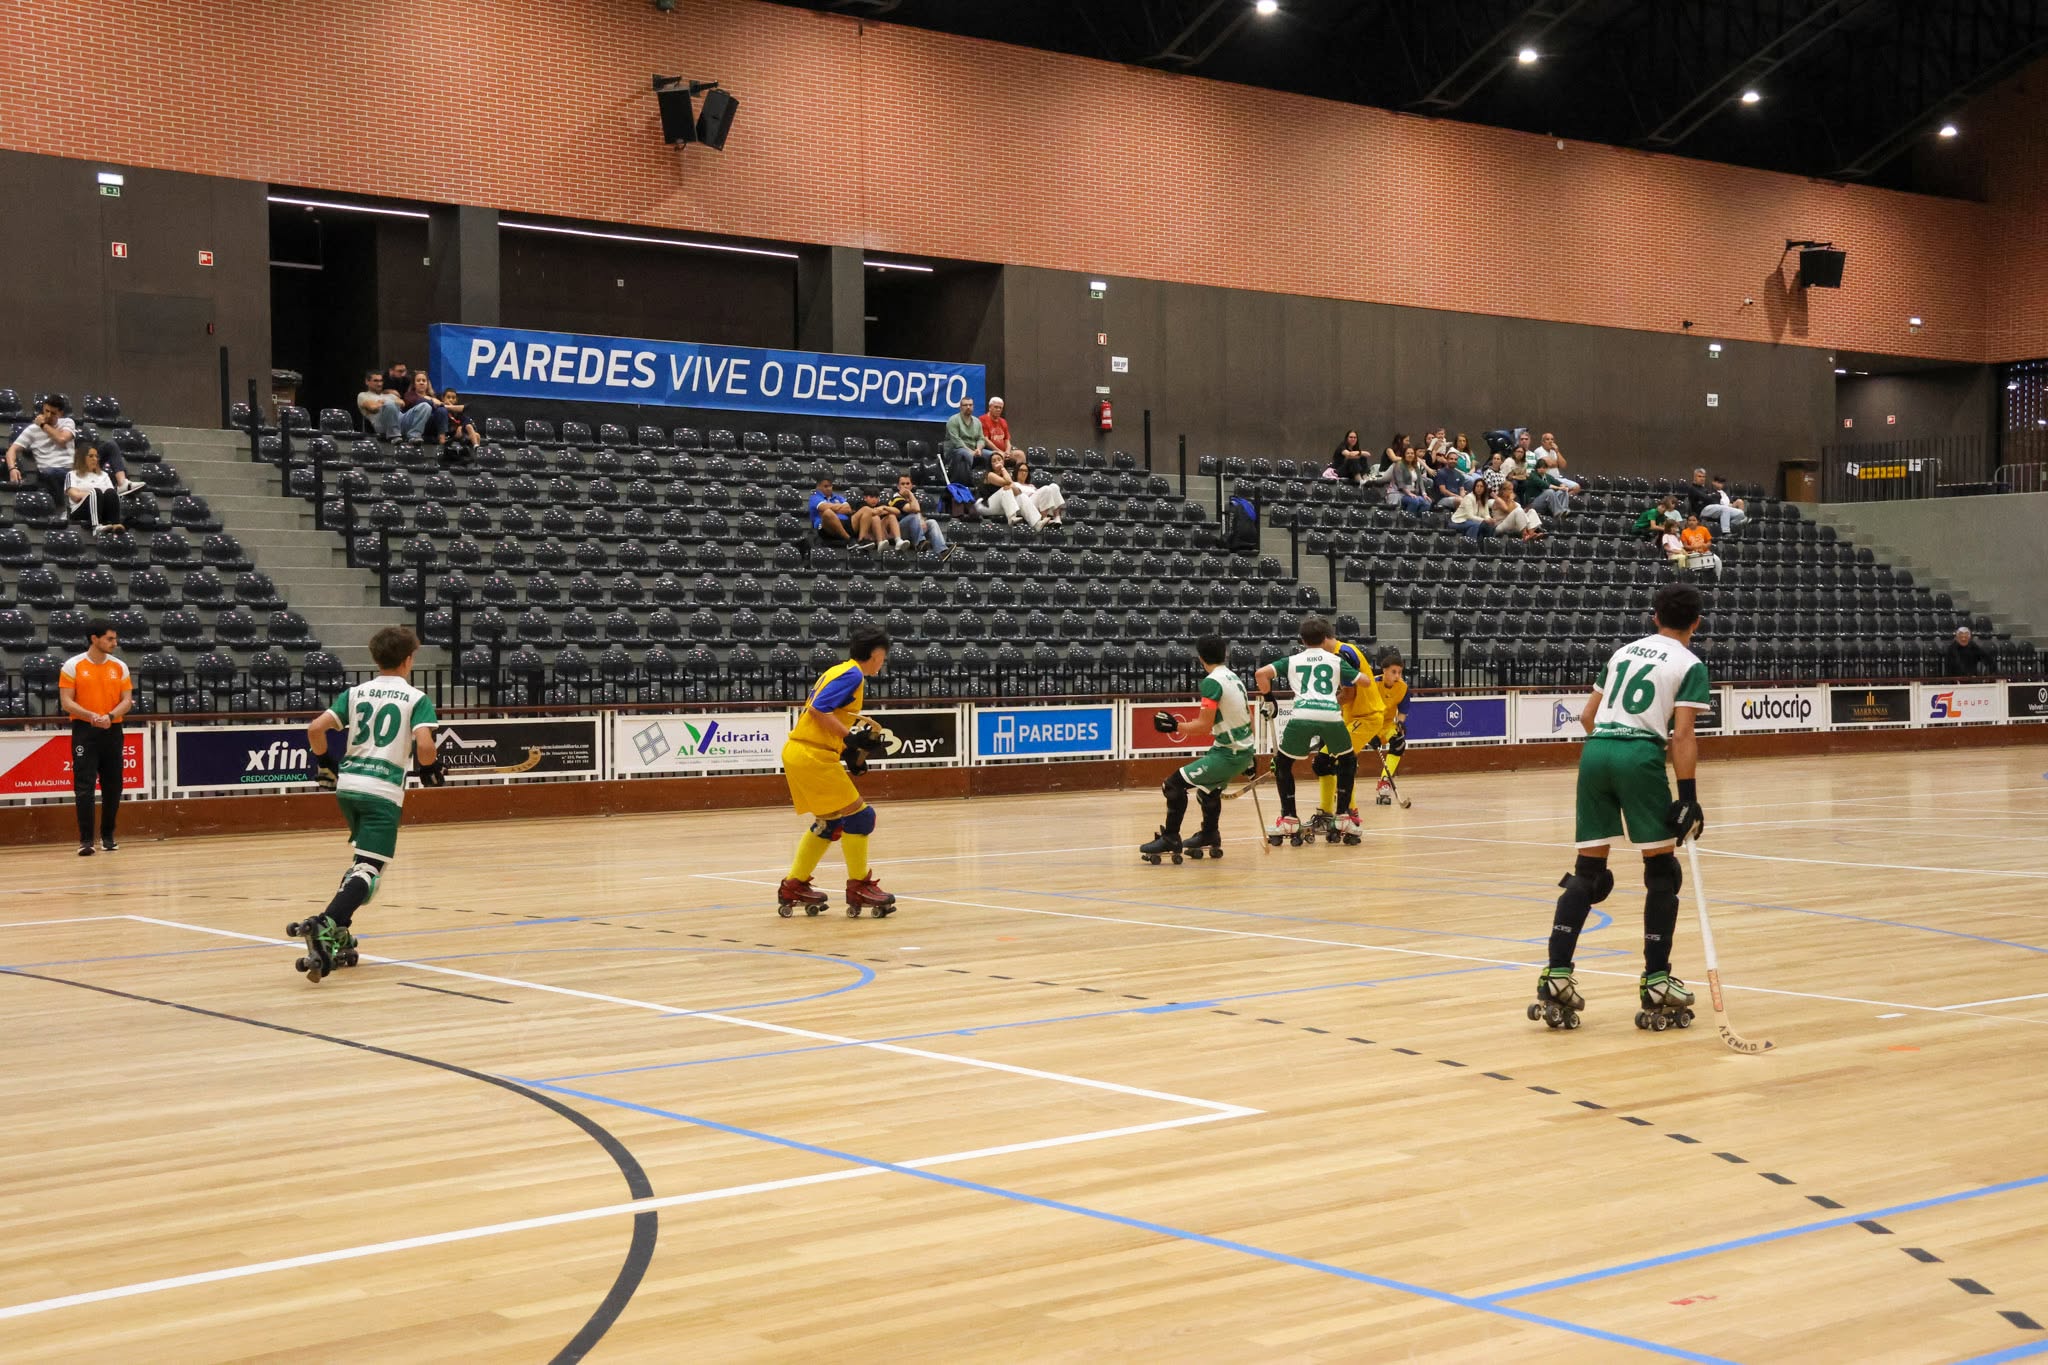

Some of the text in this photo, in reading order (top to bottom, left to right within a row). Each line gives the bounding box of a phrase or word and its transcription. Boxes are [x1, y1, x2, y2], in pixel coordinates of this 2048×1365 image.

[467, 338, 968, 409] PAREDES VIVE O DESPORTO
[1306, 655, 1323, 663] KIKO
[1626, 645, 1669, 663] VASCO A.
[1295, 663, 1334, 695] 78
[1607, 659, 1657, 715] 16
[369, 688, 410, 702] BAPTISTA
[1741, 693, 1812, 723] autocrip
[352, 701, 402, 748] 30
[1019, 722, 1099, 743] PAREDES
[34, 779, 71, 787] MÁQUINA
